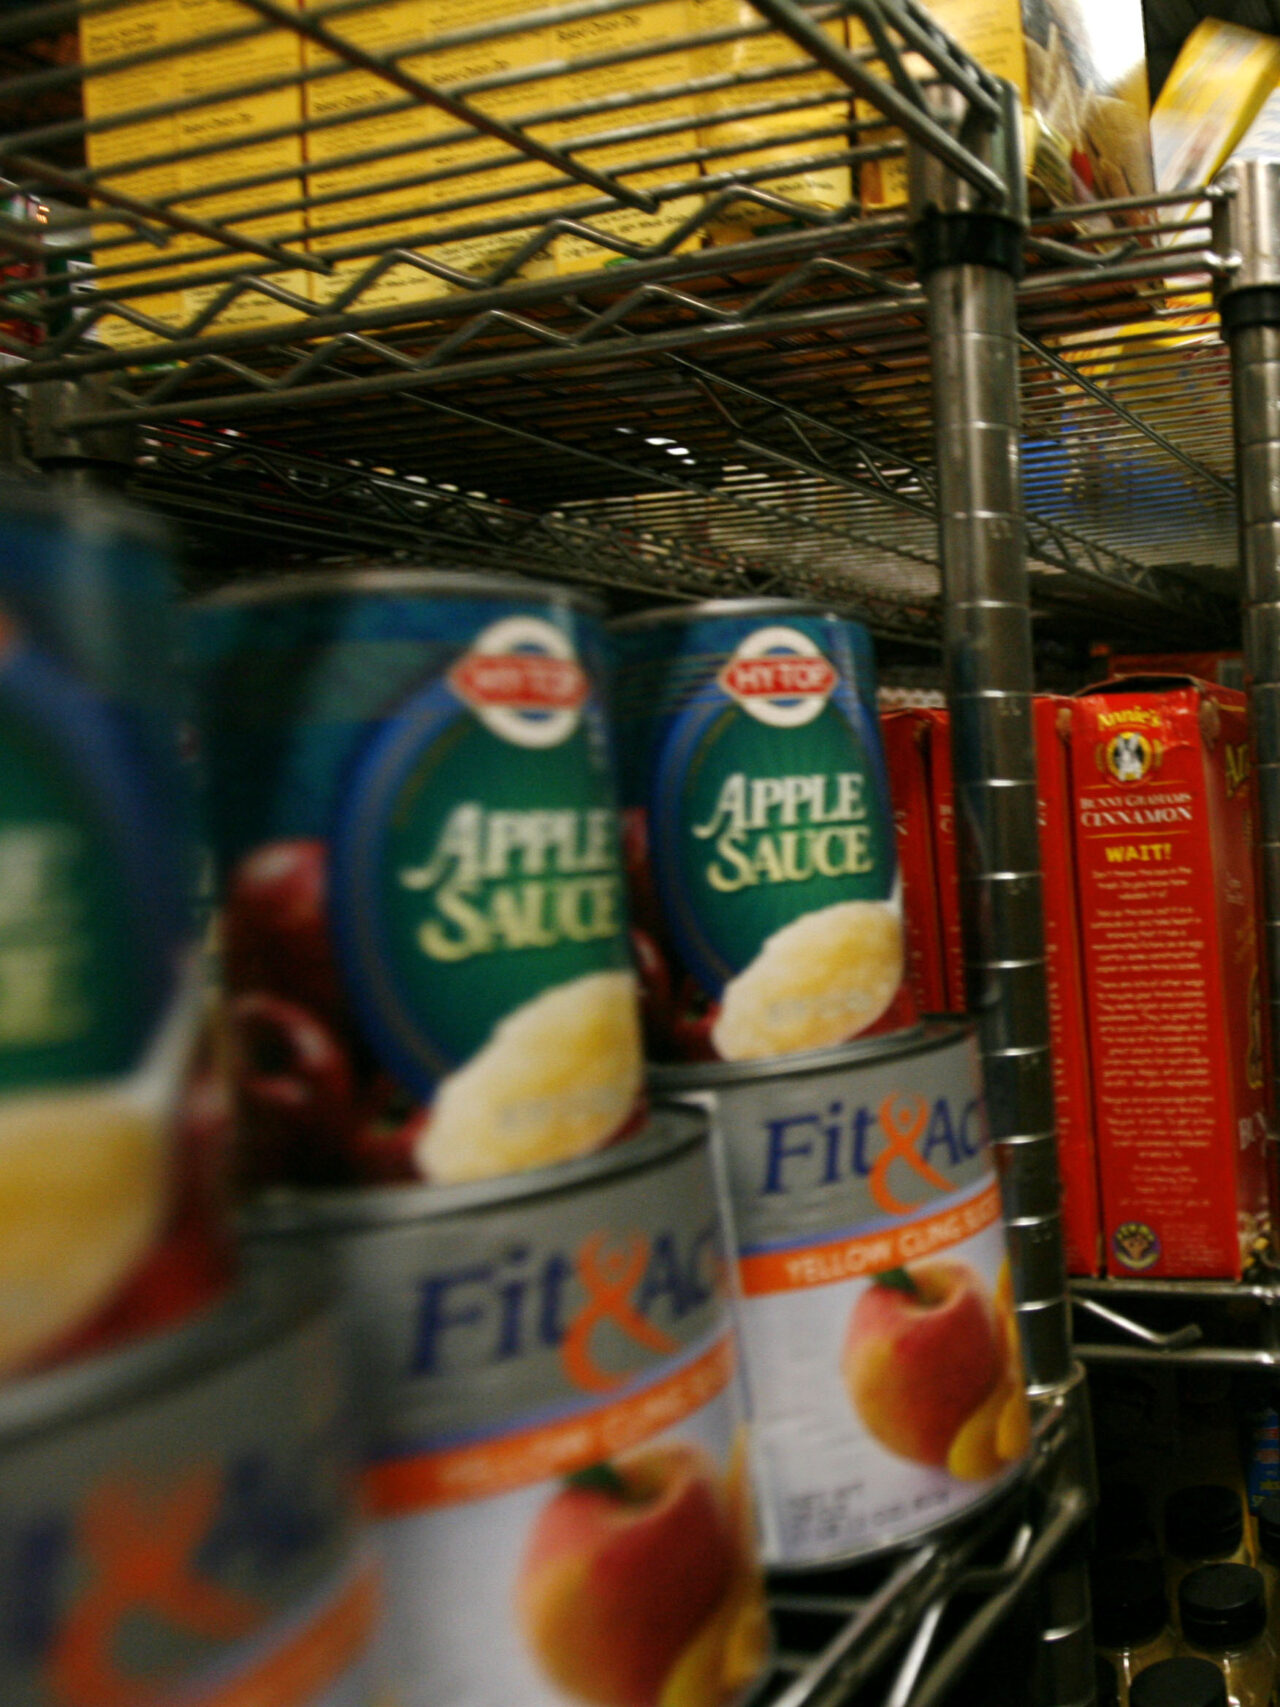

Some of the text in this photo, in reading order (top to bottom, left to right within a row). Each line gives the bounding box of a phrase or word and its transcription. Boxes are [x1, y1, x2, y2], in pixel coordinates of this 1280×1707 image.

[692, 772, 867, 840] APPLE
[1080, 806, 1193, 827] CINNAMON
[399, 801, 616, 890] APPLE
[707, 825, 875, 893] SAUCE
[417, 873, 621, 964] SAUCE
